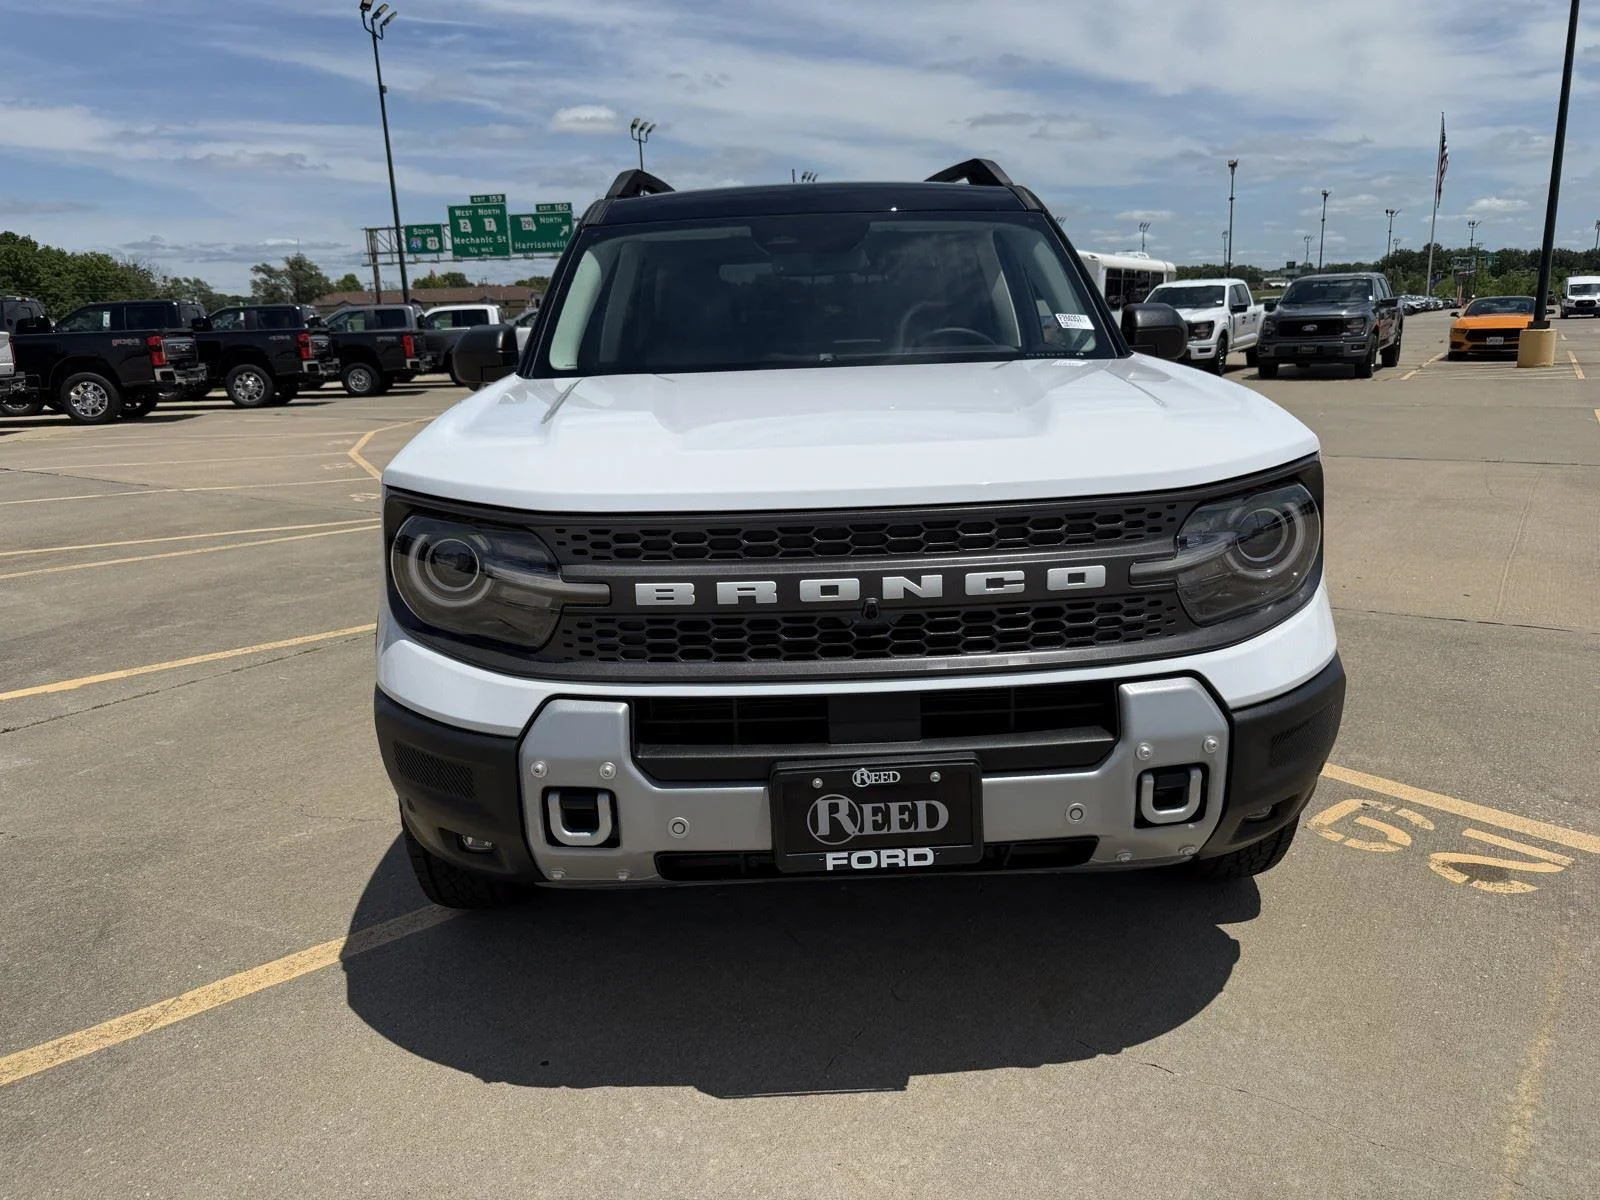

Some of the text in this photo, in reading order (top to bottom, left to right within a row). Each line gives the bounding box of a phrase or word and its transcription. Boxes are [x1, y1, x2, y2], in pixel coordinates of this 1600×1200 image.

[489, 195, 503, 203] 159
[454, 209, 473, 217] WEST
[539, 216, 562, 224] NORTH
[453, 237, 493, 245] Mechanic
[515, 241, 567, 250] Harrisonvill
[635, 565, 1107, 606] BRONCO
[852, 768, 901, 787] REED
[806, 793, 950, 846] REED
[826, 848, 935, 871] FORD
